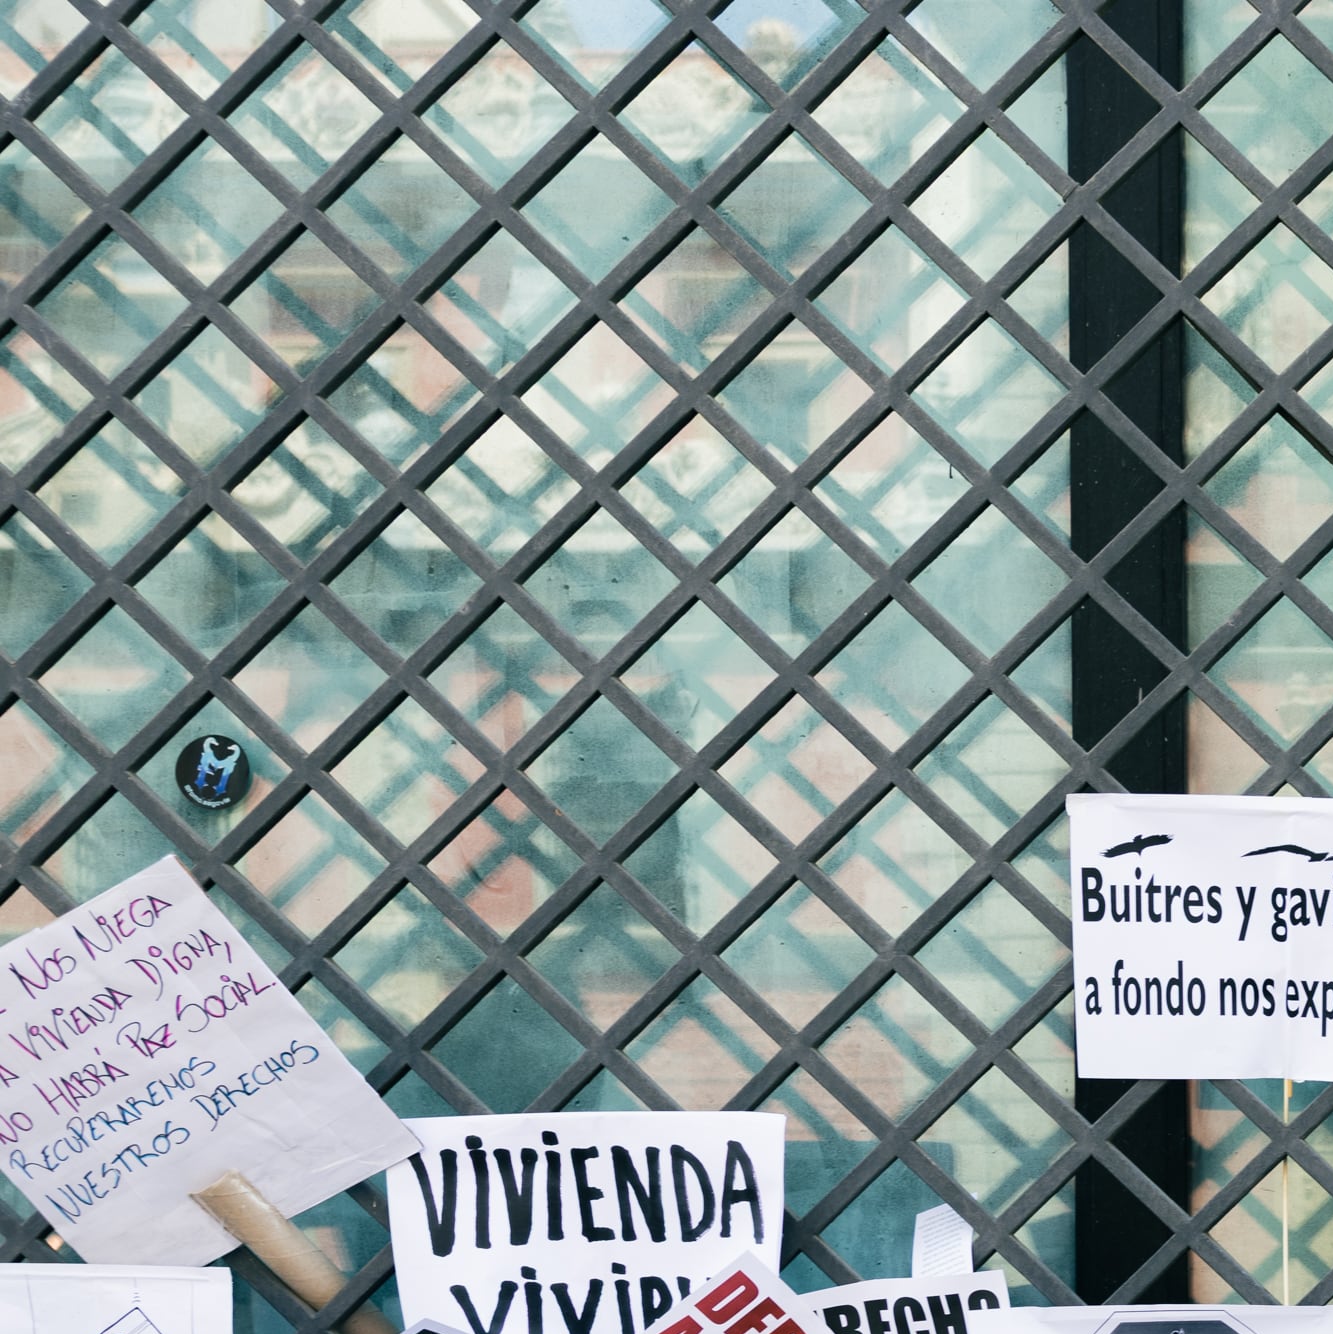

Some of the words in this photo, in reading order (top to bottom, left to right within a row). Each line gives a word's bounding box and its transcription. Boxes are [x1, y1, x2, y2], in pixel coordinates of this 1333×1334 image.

[1081, 866, 1222, 923] Buitres
[1234, 885, 1257, 941] y
[1085, 976, 1101, 1016] a
[1113, 960, 1206, 1017] fondo
[1219, 976, 1276, 1017] nos
[10, 1057, 218, 1180] RECUPERAREMOS
[45, 1120, 190, 1224] NUESTROS
[191, 1039, 320, 1131] DERECHOS
